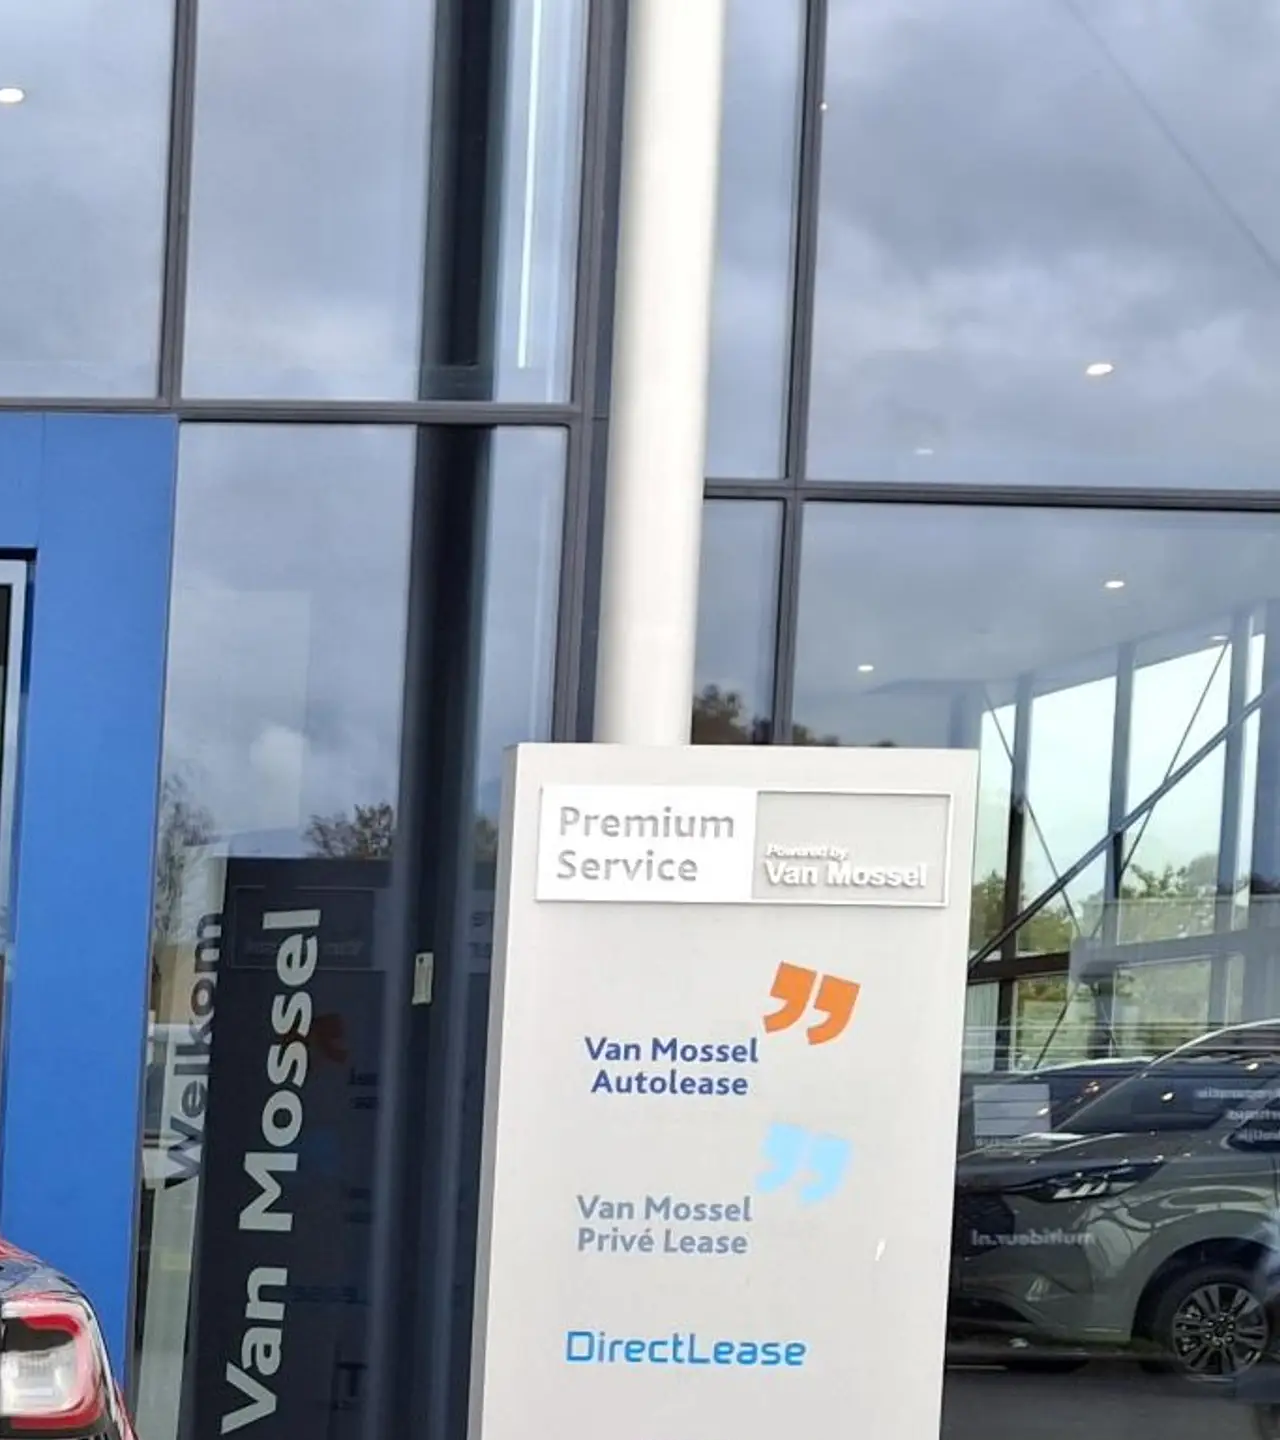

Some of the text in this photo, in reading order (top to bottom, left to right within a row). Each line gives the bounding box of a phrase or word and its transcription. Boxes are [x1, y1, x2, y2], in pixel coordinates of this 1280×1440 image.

[559, 806, 734, 839] Premium
[556, 850, 699, 883] Service
[765, 861, 927, 889] Van Mossel
[585, 1037, 759, 1064] Van Mossel
[238, 909, 322, 1233] Mossel
[591, 1069, 748, 1096] Autolease
[577, 1195, 751, 1223] Van Mossel
[577, 1228, 748, 1254] Privé Lease
[220, 1266, 288, 1435] Van
[566, 1331, 807, 1367] DirectLease
